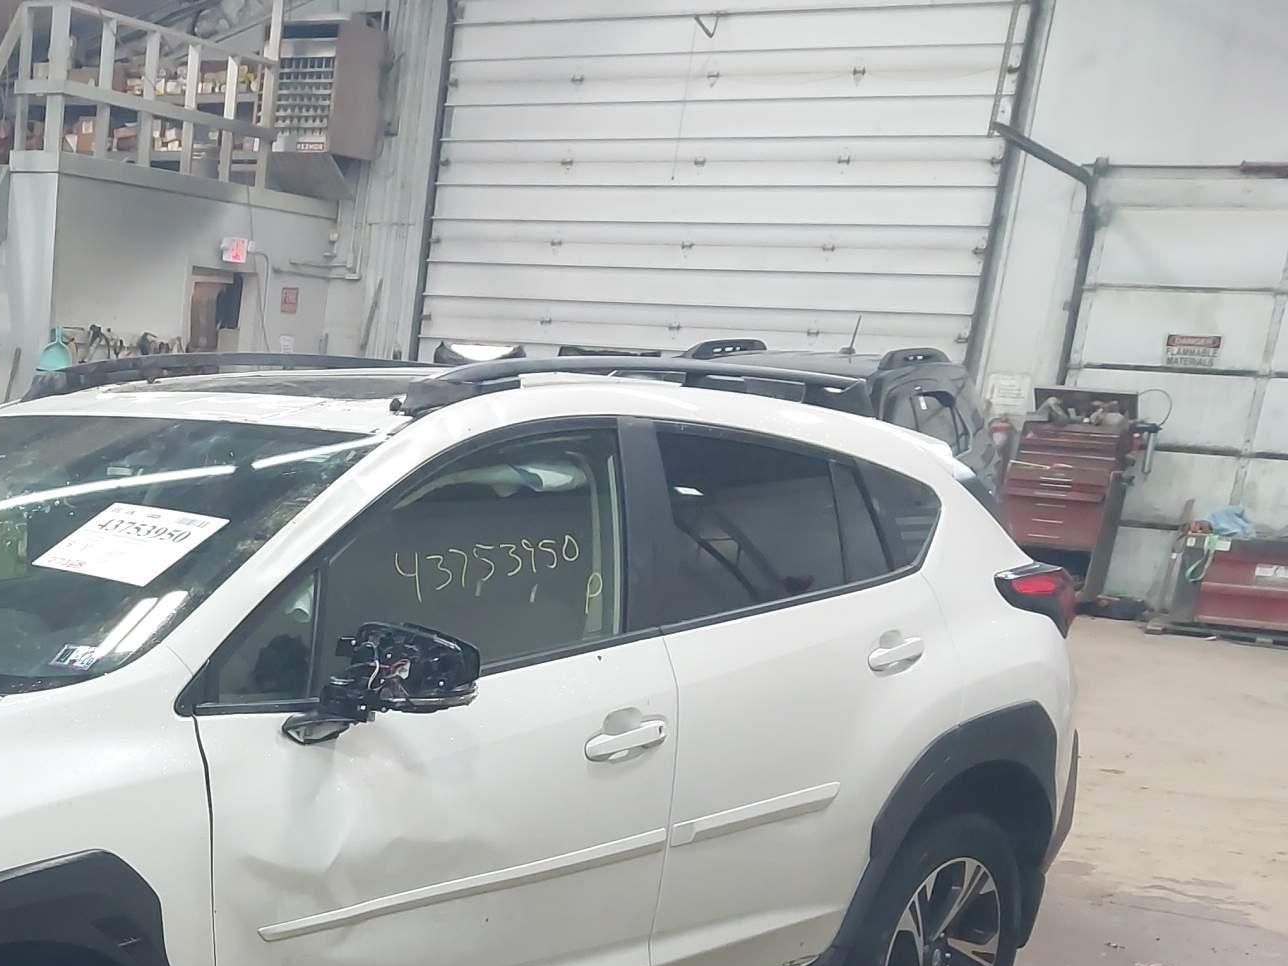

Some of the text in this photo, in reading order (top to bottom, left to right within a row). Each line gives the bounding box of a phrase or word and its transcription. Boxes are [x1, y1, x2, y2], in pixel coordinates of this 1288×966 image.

[1166, 348, 1217, 357] FLAMMABLE
[1166, 356, 1214, 366] MATERIALS
[97, 518, 192, 543] 43753950
[395, 534, 580, 602] 43753950
